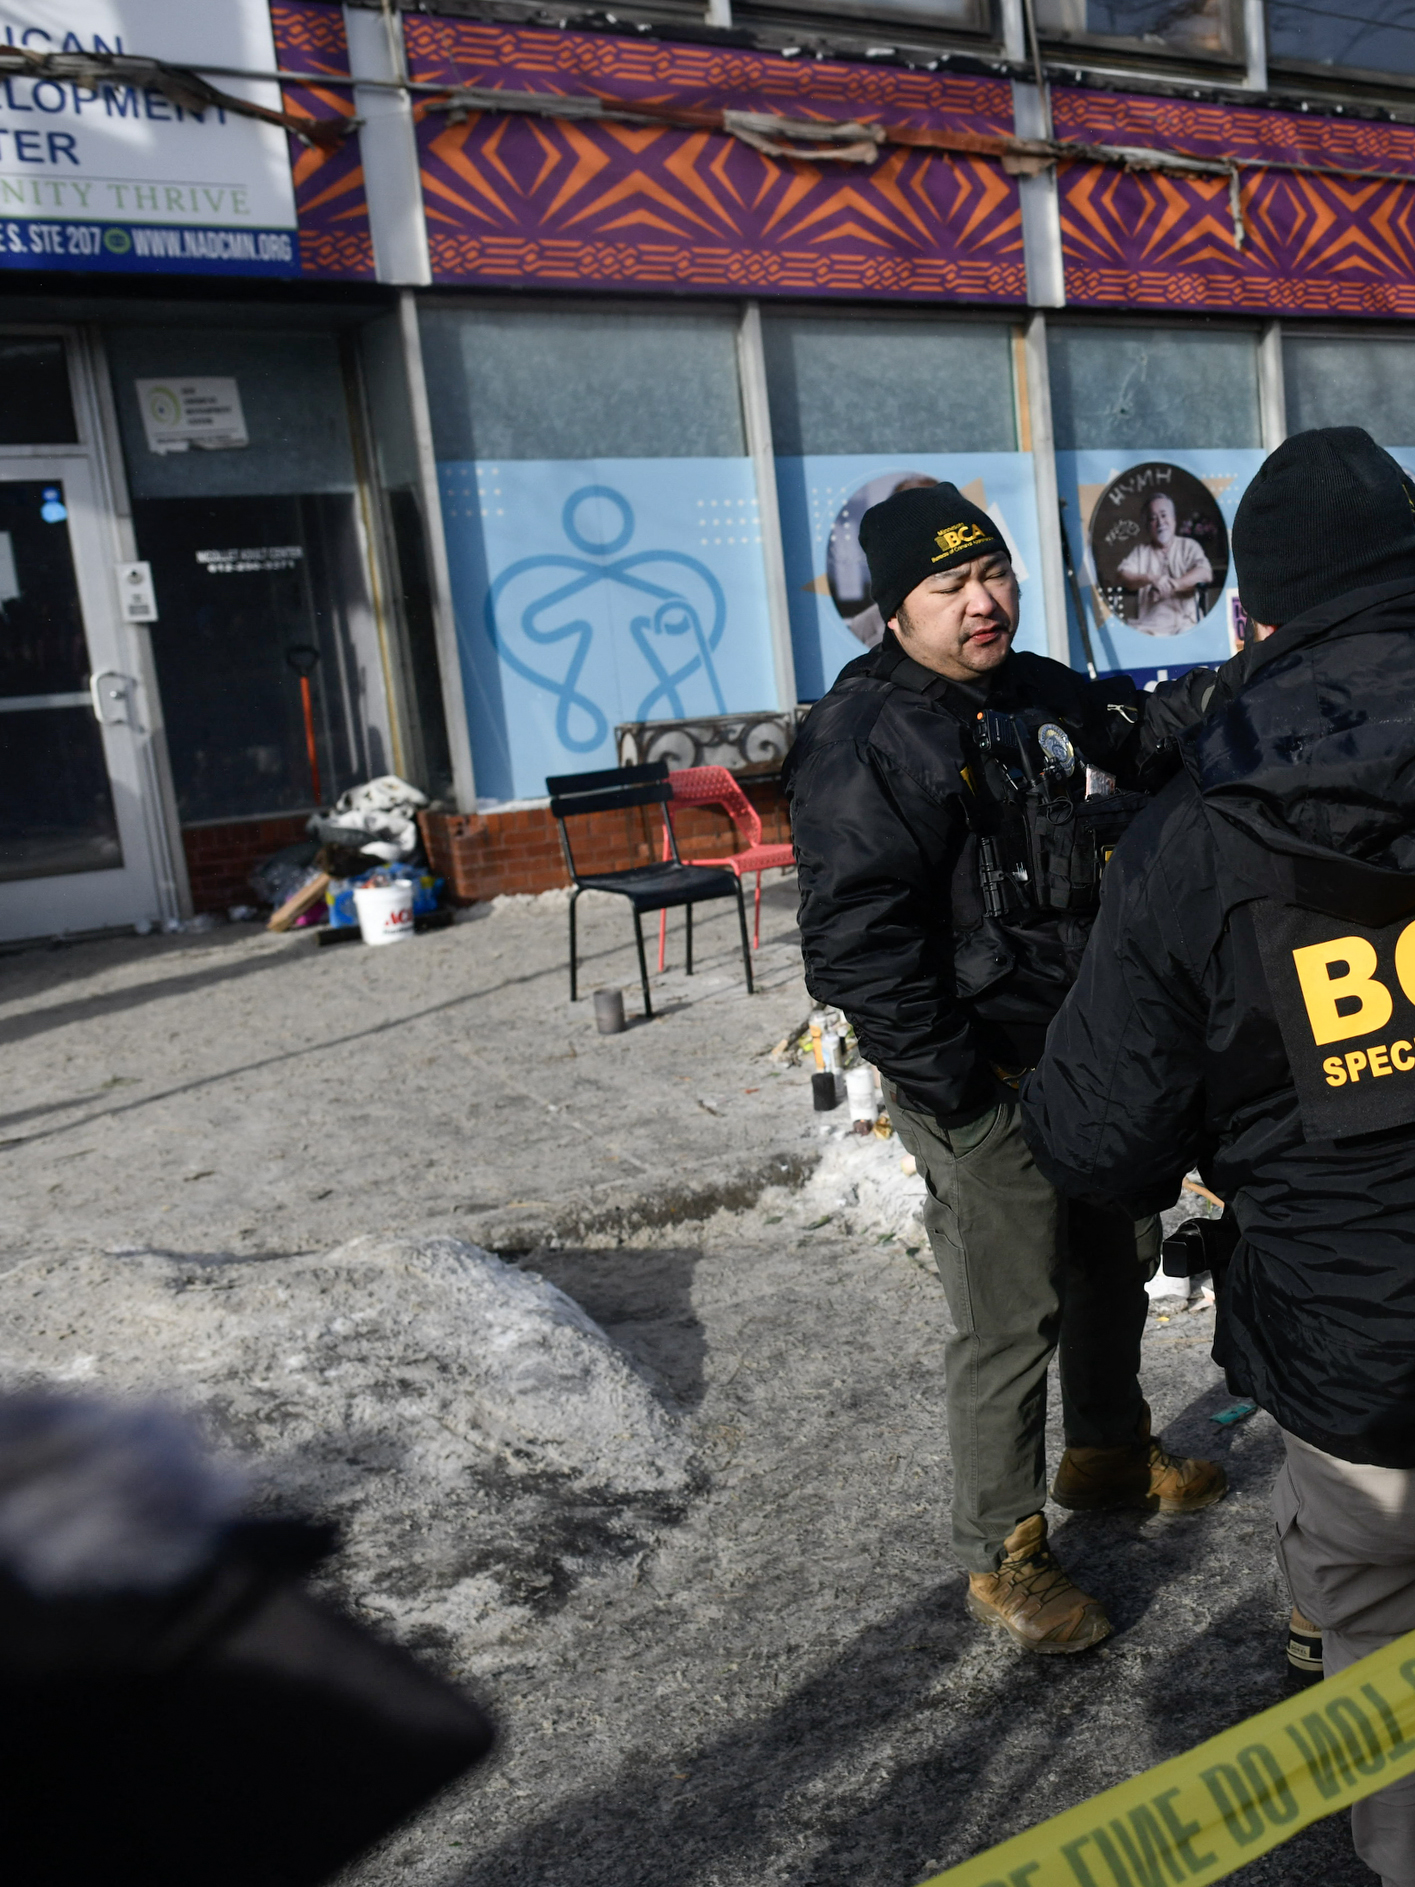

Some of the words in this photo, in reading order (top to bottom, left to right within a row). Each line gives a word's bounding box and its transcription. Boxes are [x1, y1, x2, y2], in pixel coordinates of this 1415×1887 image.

[106, 184, 250, 215] THRIVE
[28, 223, 65, 254] STE
[66, 226, 101, 255] 207
[131, 228, 292, 261] WWW.NADCMN.ORG
[944, 524, 986, 548] BCA
